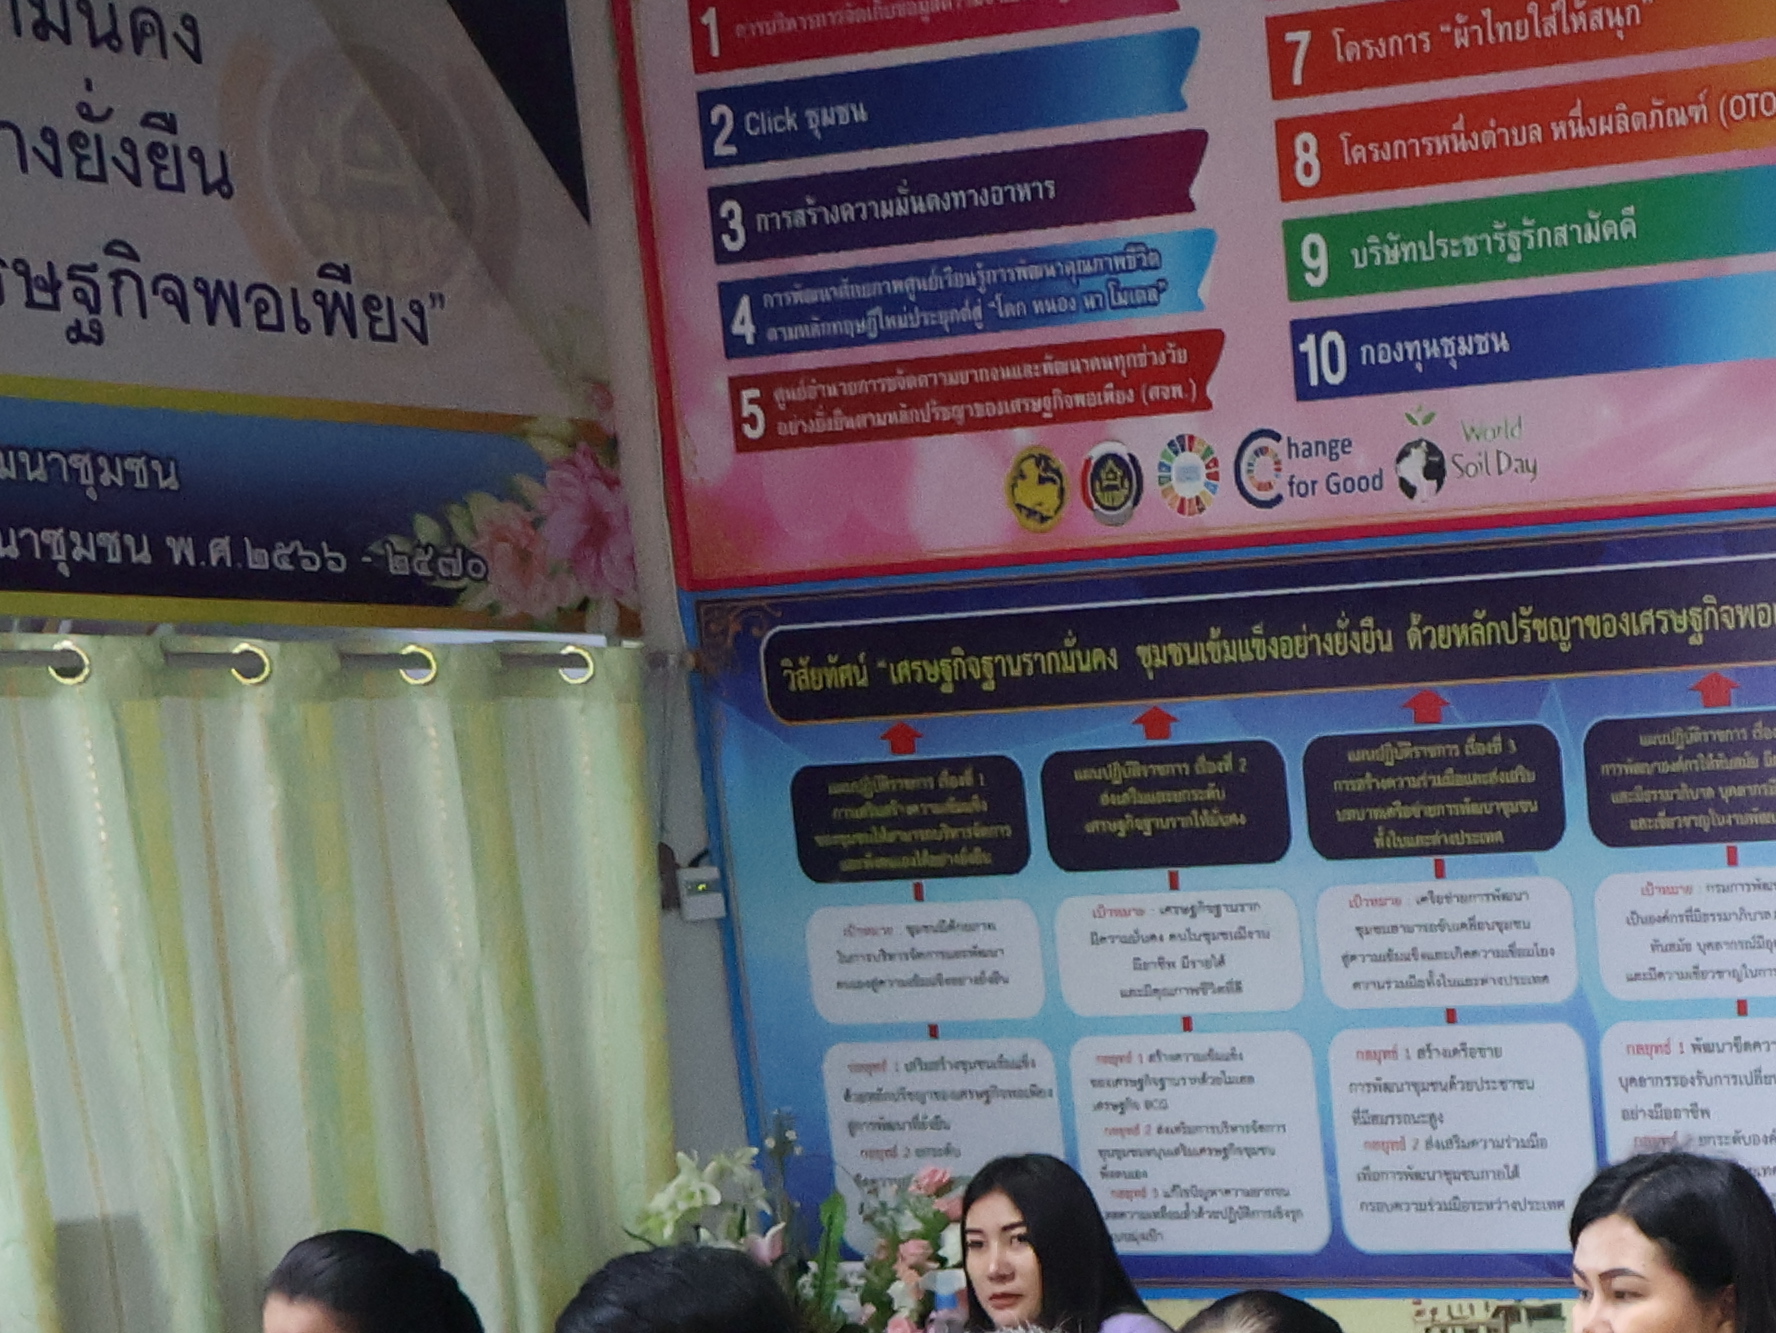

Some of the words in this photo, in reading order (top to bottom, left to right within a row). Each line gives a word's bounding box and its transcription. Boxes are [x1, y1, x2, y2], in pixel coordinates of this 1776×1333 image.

[700, 6, 721, 57] 1
[1284, 30, 1312, 87] 7
[1331, 27, 1431, 64] โครงการ
[709, 104, 737, 157] 2
[744, 110, 798, 138] Click
[806, 101, 869, 141] ชุมชน
[1294, 132, 1321, 188] 8
[1338, 113, 1544, 166] โครงการหนึ่งตำบล
[1551, 95, 1709, 143] หนึ่งผลิตภัณฑ์
[720, 200, 747, 252] 3
[756, 178, 1057, 235] การสร้างความมั่นคงทางอาหาร
[1301, 234, 1328, 288] 9
[1351, 205, 1638, 270] บริษัทประชารัฐรักสามัคคี
[0, 238, 446, 346] ษฐกิจพอเพียง”
[730, 294, 756, 346] 4
[1298, 330, 1347, 386] 10
[1360, 328, 1511, 374] กองทุนชุมชน
[740, 388, 766, 440] 5
[1461, 416, 1524, 443] World
[1287, 474, 1319, 499] for
[1325, 468, 1384, 497] Good
[1452, 451, 1489, 479] Soil
[1495, 449, 1539, 483] Day
[781, 652, 868, 692] วิสัยทัศน์
[1137, 610, 1394, 681] ชุมชนเข้มแข็งอย่างยั่งยืน
